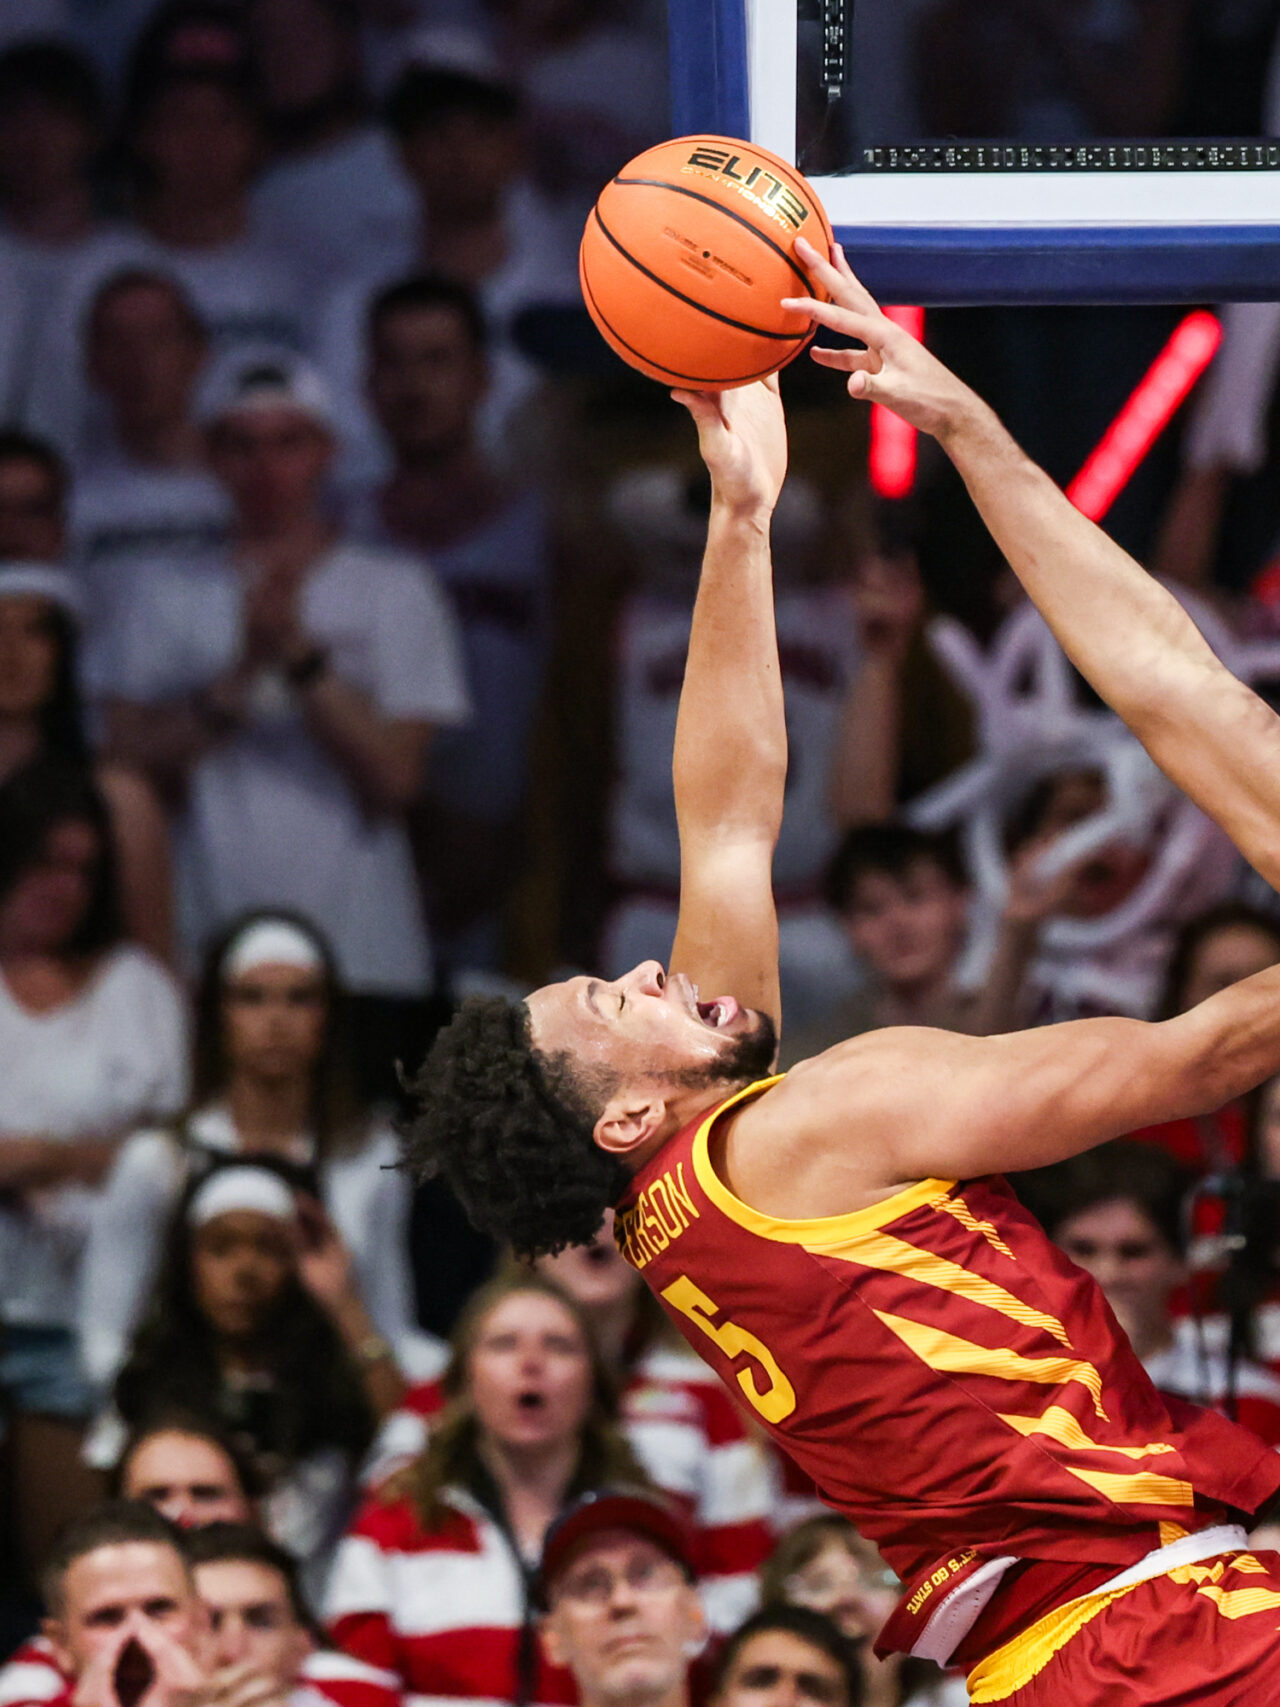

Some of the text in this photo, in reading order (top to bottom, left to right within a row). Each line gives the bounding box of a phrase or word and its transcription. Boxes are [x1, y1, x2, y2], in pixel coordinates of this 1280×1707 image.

[686, 146, 809, 230] ELITE
[660, 1274, 797, 1424] 5
[906, 1580, 933, 1615] STATE
[930, 1567, 950, 1586] GO
